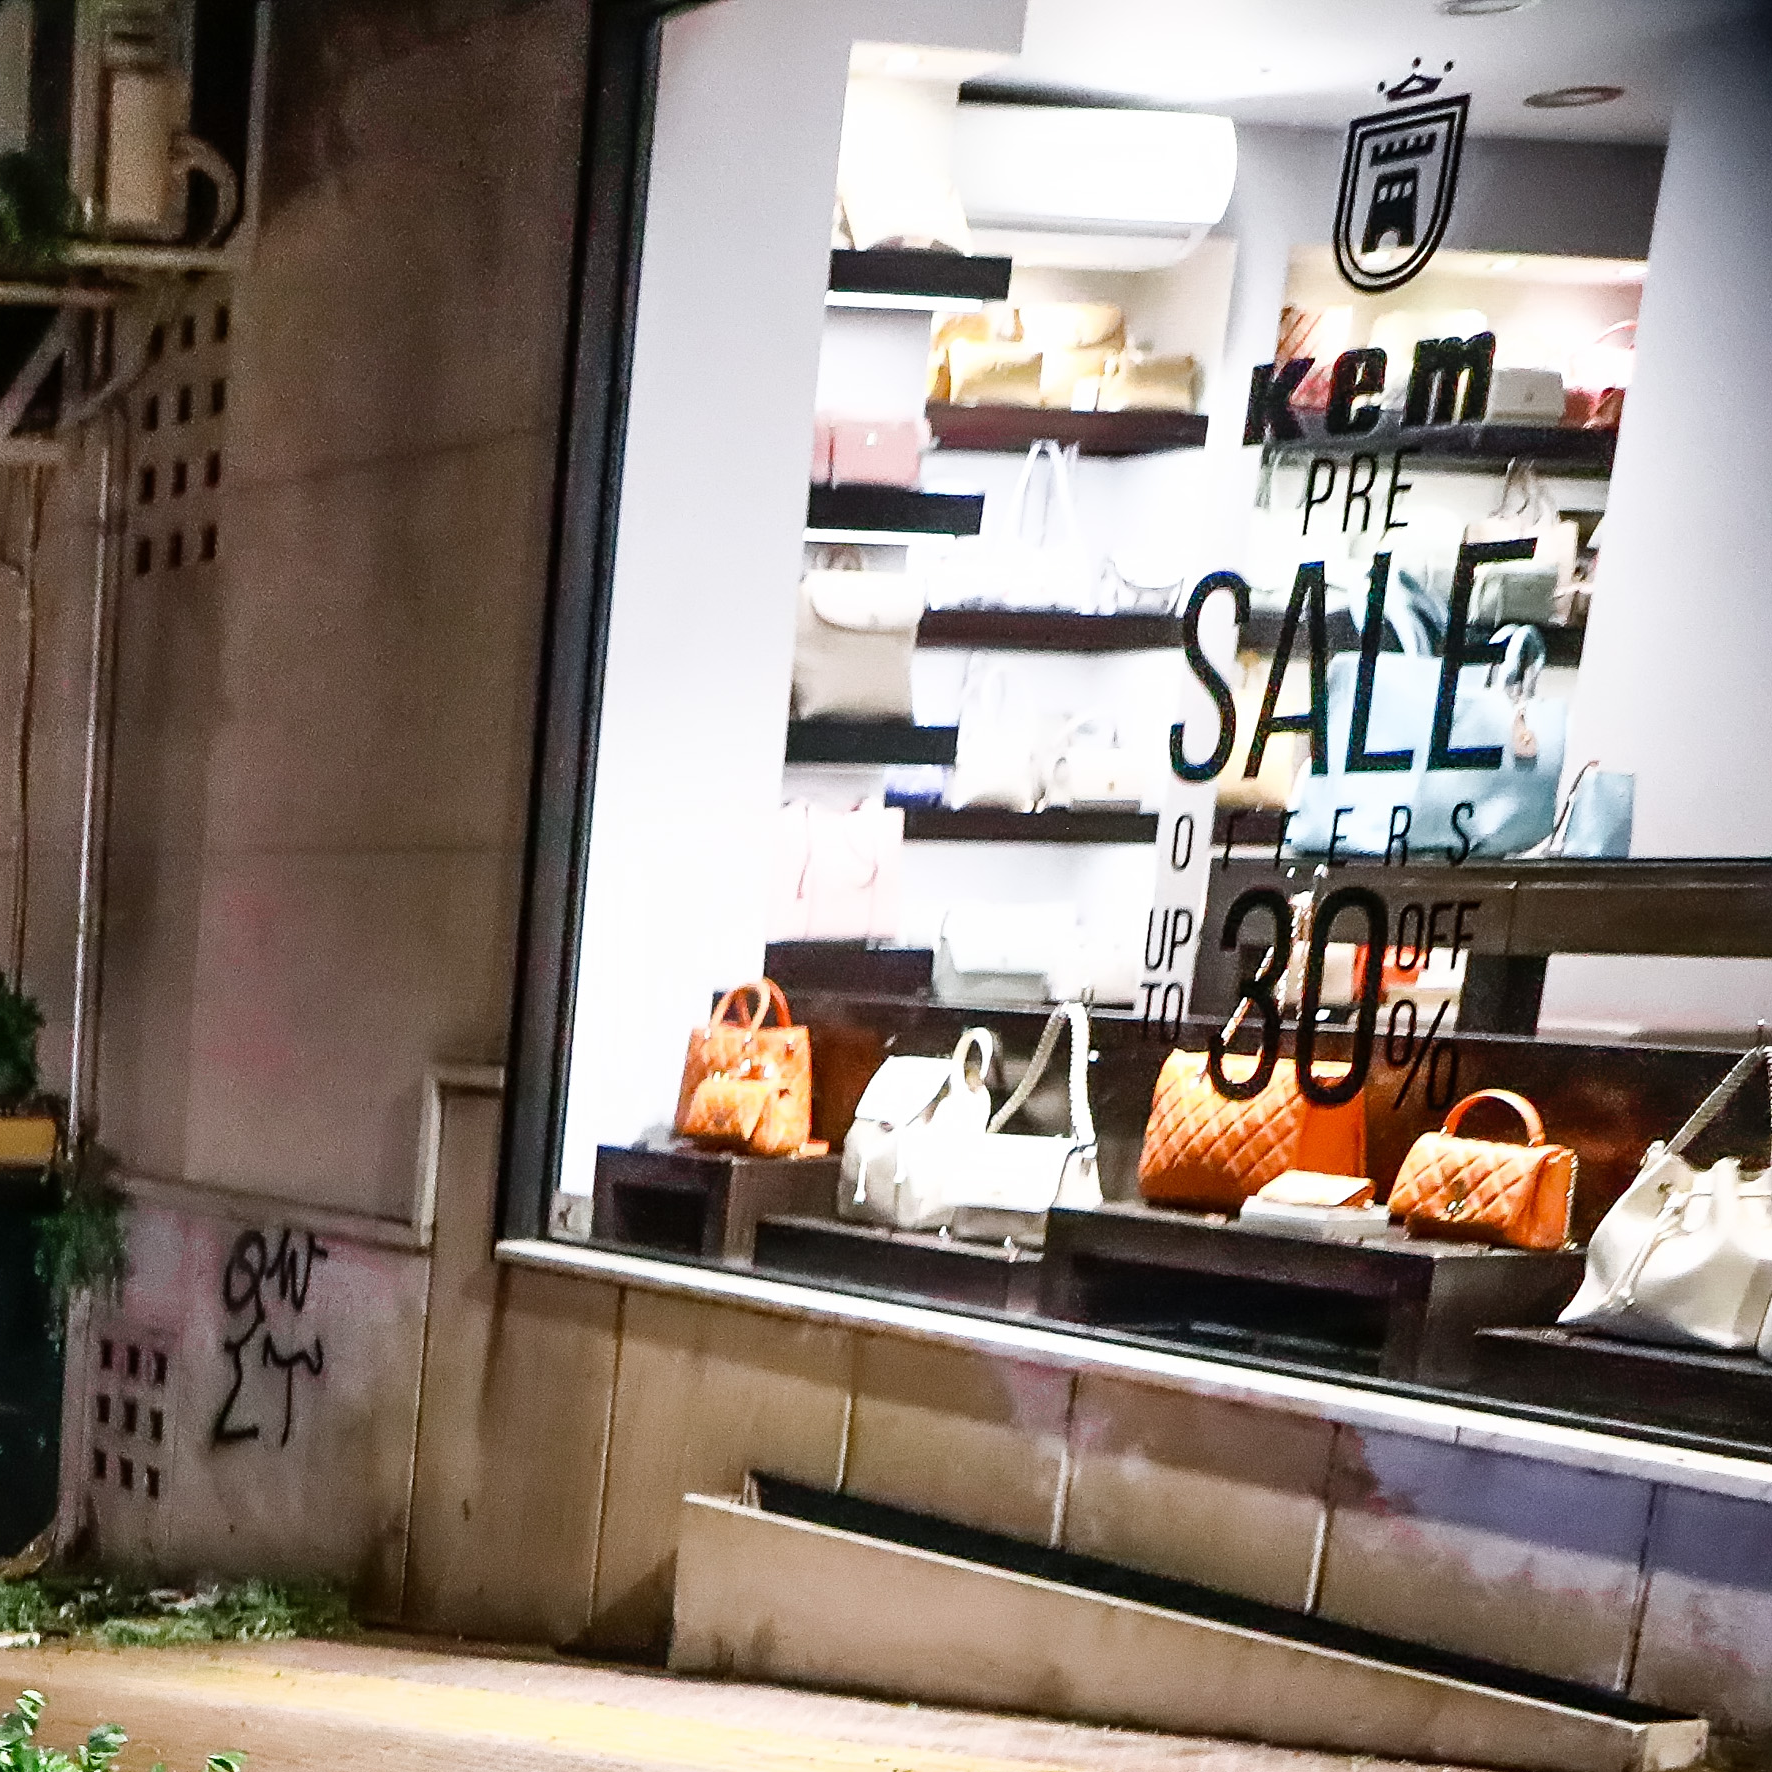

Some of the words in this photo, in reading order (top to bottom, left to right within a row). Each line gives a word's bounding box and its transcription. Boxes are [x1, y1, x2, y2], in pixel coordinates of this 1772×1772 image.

[1242, 331, 1496, 446] kem
[1302, 446, 1422, 536] PRE
[1169, 537, 1538, 783] SALE
[1170, 801, 1475, 873] OFFERS
[1145, 908, 1193, 971] UP
[1396, 902, 1482, 971] OFF
[1140, 982, 1184, 1042] TO
[1206, 886, 1389, 1105] 30
